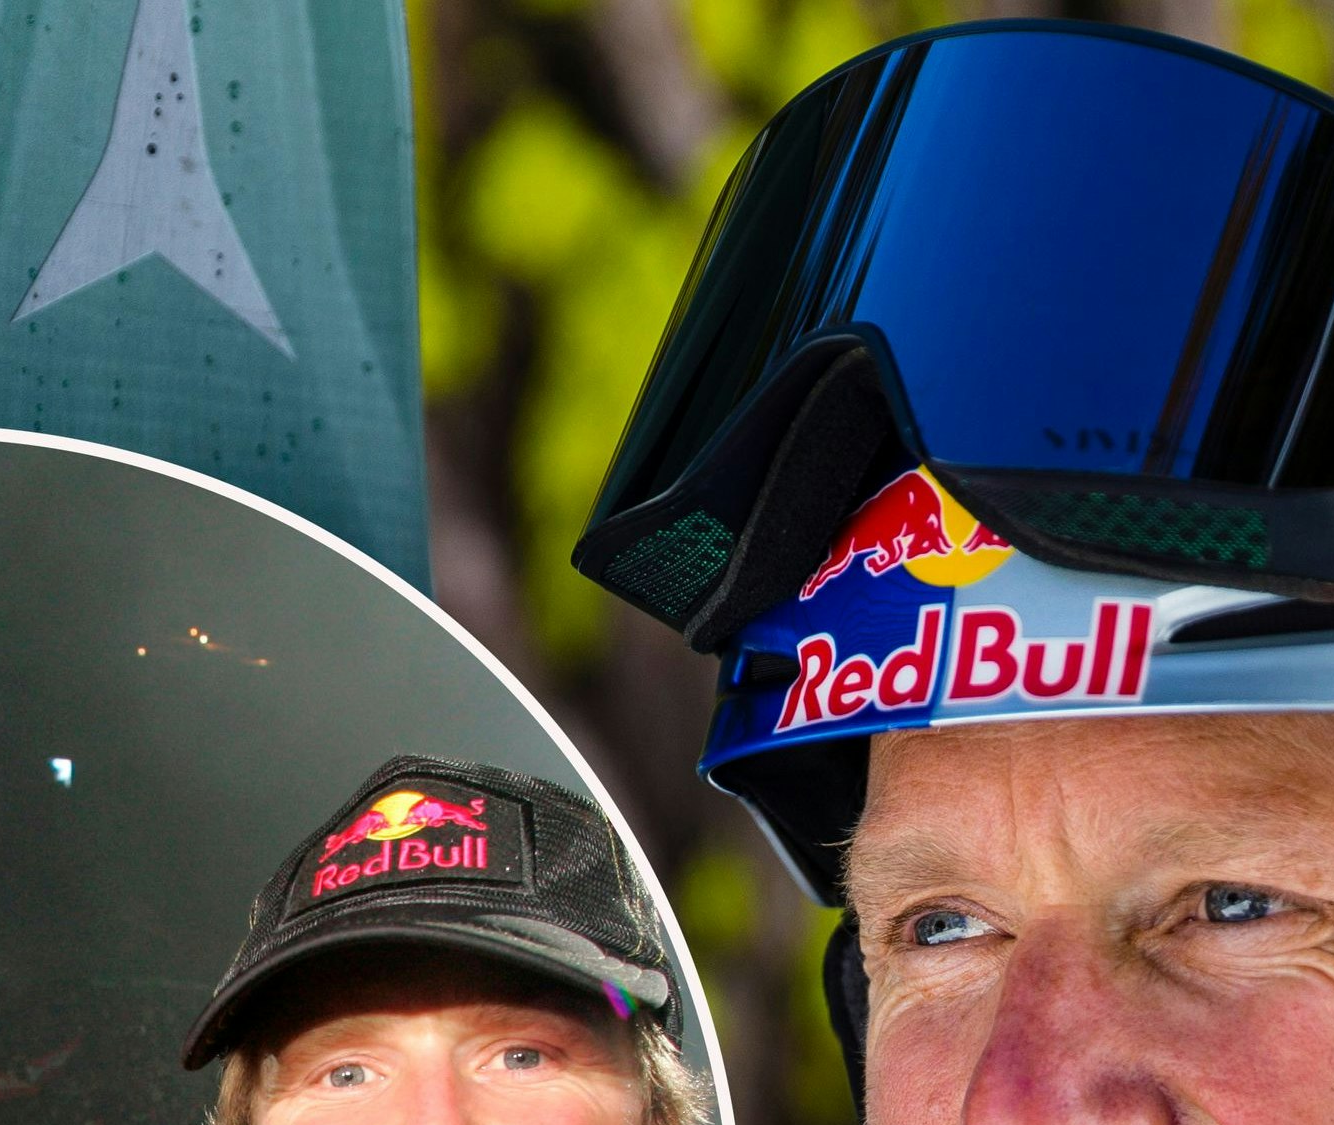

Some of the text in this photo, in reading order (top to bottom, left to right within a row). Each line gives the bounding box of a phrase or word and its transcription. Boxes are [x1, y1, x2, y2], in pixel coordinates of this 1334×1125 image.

[775, 600, 1155, 732] Red Bull
[312, 834, 488, 897] Red Bull
